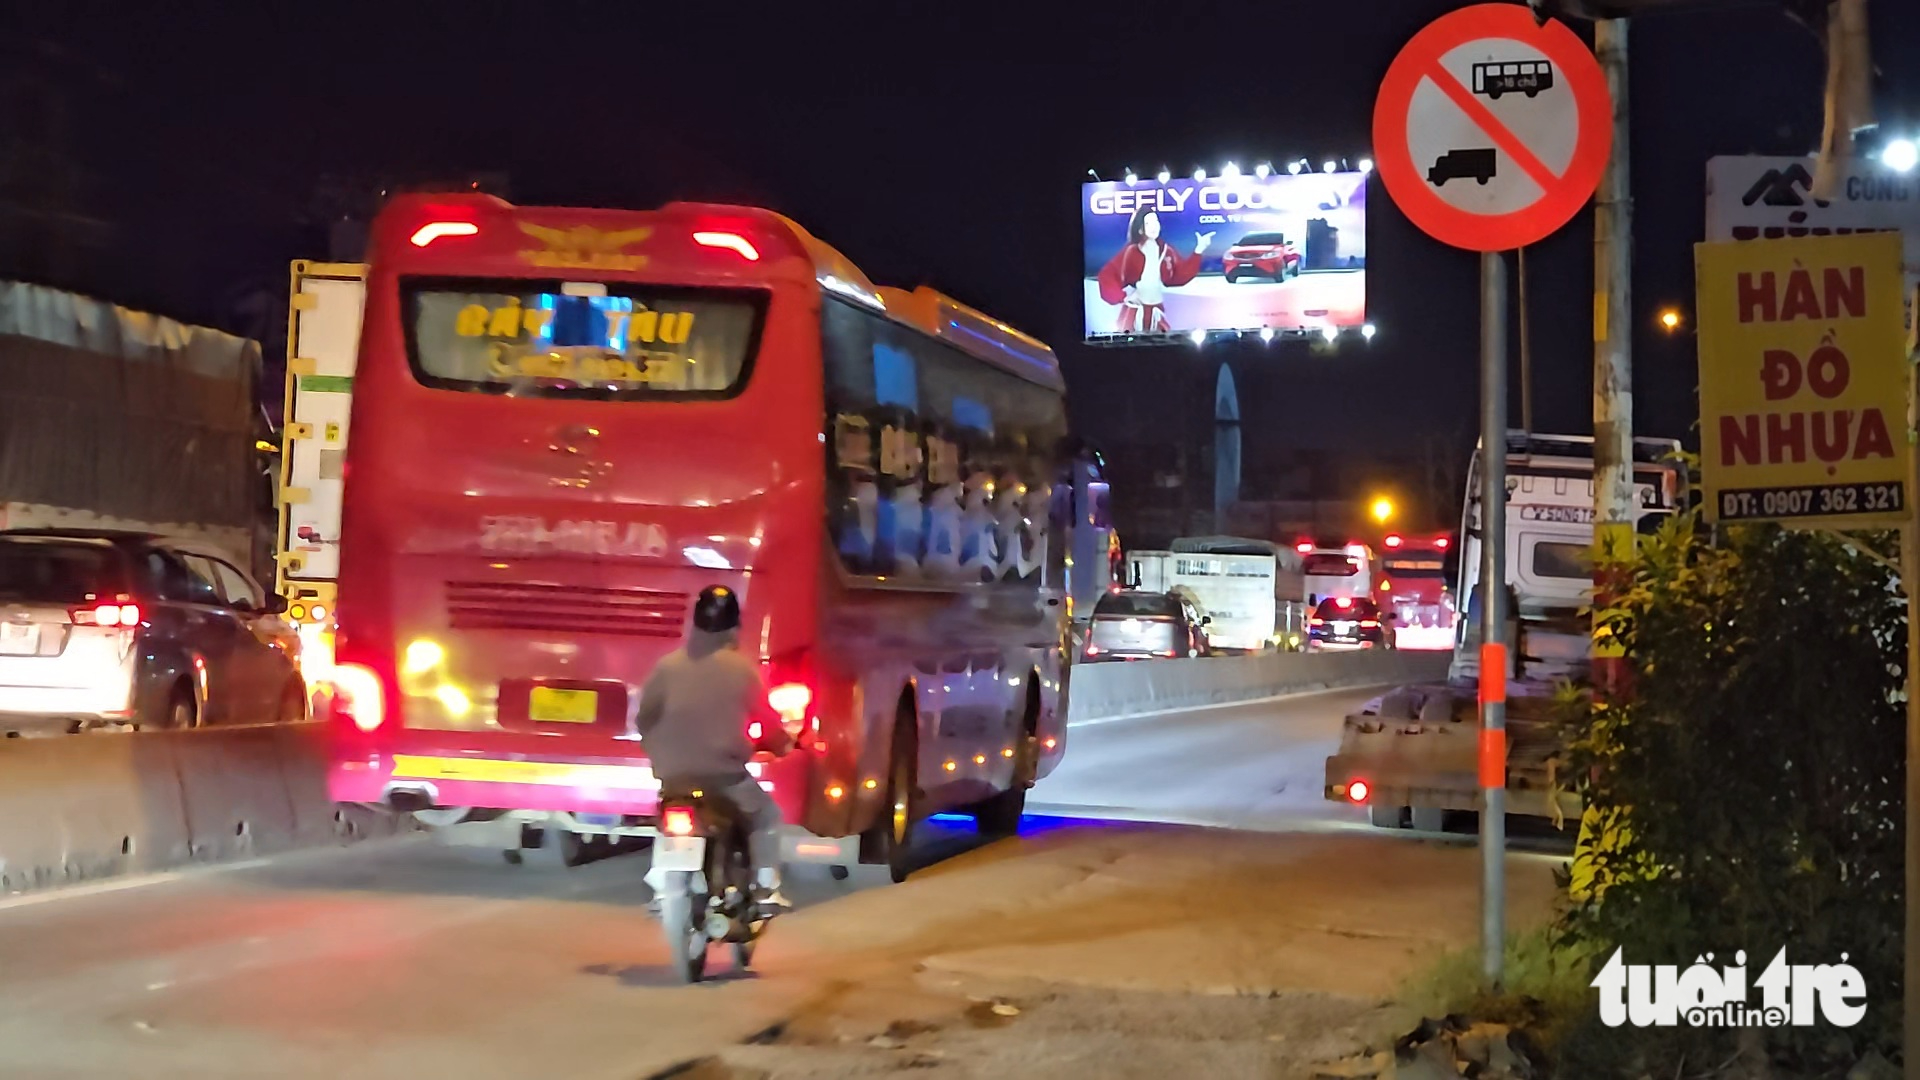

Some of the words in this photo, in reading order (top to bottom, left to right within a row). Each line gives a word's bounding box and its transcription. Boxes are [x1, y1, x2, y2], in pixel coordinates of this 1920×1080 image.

[1090, 186, 1193, 215] GEELY
[1737, 258, 1866, 323] HÀN
[1760, 328, 1850, 400] ĐỒ
[1719, 408, 1894, 476] NHỰA
[1763, 490, 1813, 515] 0907
[1820, 487, 1858, 512] 362
[1864, 485, 1899, 510] 321
